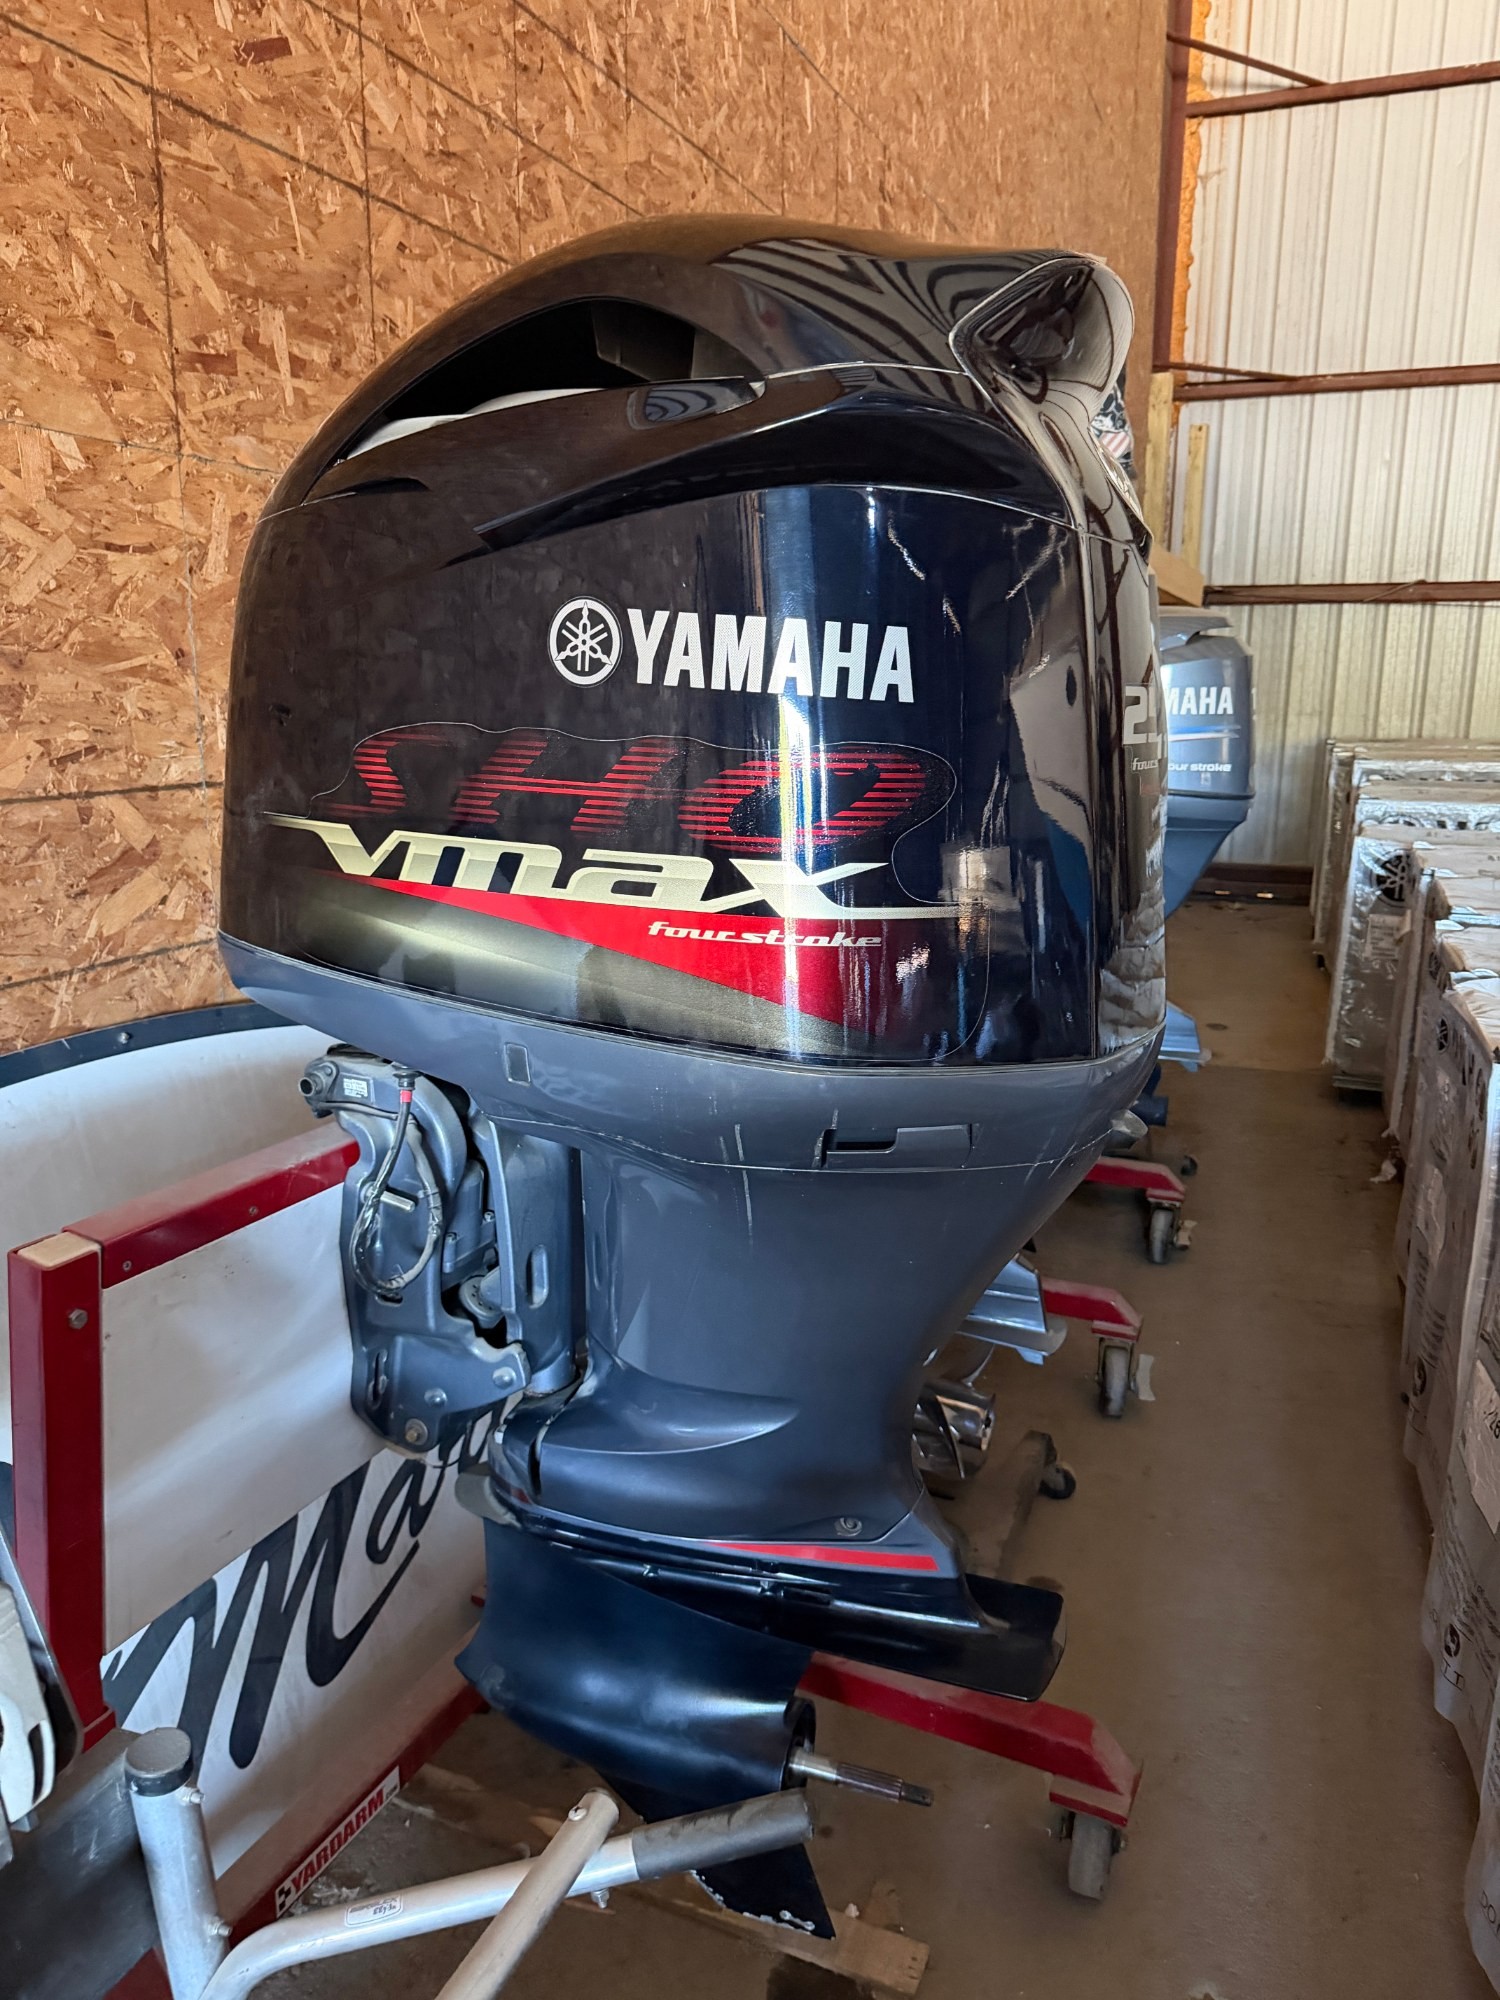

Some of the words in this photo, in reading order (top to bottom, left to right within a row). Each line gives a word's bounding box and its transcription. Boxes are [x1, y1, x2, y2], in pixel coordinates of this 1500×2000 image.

[627, 608, 914, 703] YAMAHA
[1166, 686, 1234, 716] MAHA
[1167, 763, 1189, 771] our
[291, 1787, 385, 1892] YARDARM
